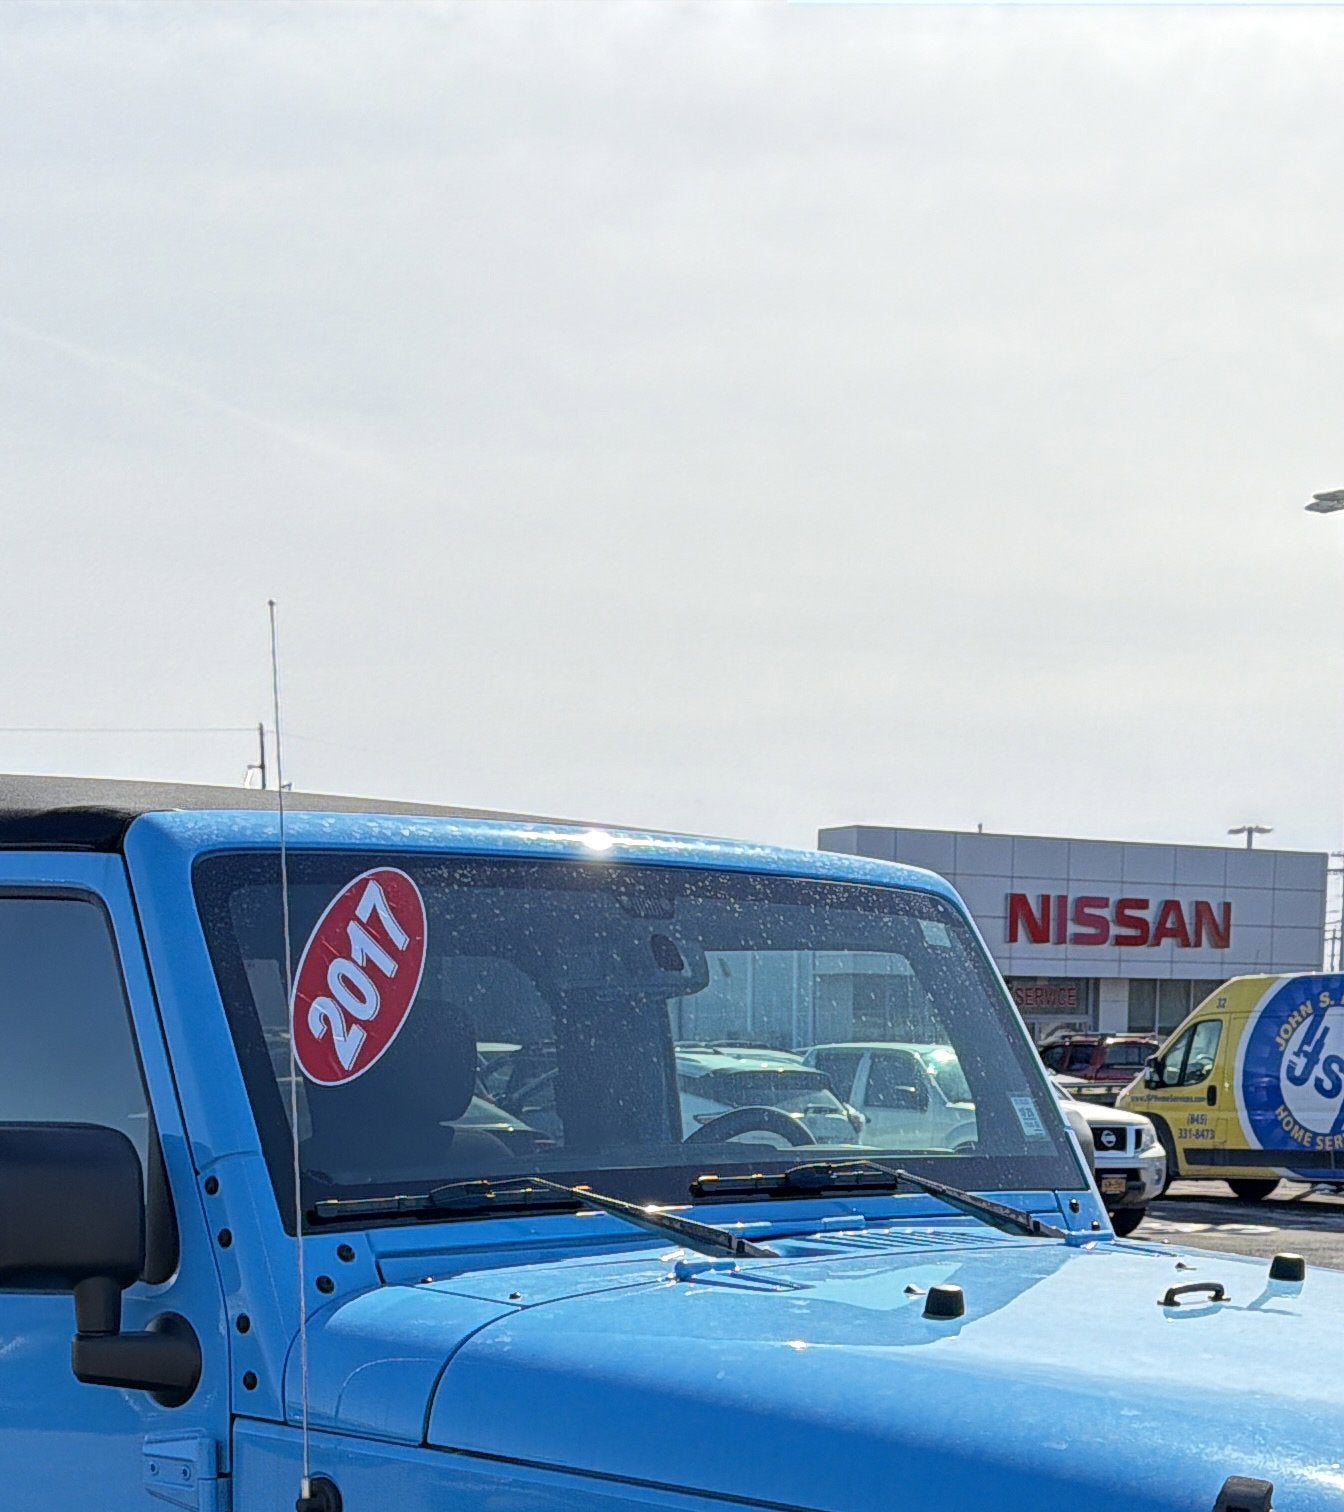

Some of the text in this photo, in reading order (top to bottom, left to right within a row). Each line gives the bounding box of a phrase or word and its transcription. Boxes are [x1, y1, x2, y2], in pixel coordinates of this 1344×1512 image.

[1006, 893, 1232, 949] NISSAN
[307, 879, 410, 1071] 2017
[1015, 987, 1077, 1007] SERVICE
[1275, 1001, 1313, 1051] JOHN
[1319, 992, 1335, 1008] S.
[1187, 1113, 1207, 1125] (845)
[1275, 1105, 1313, 1149] HOME
